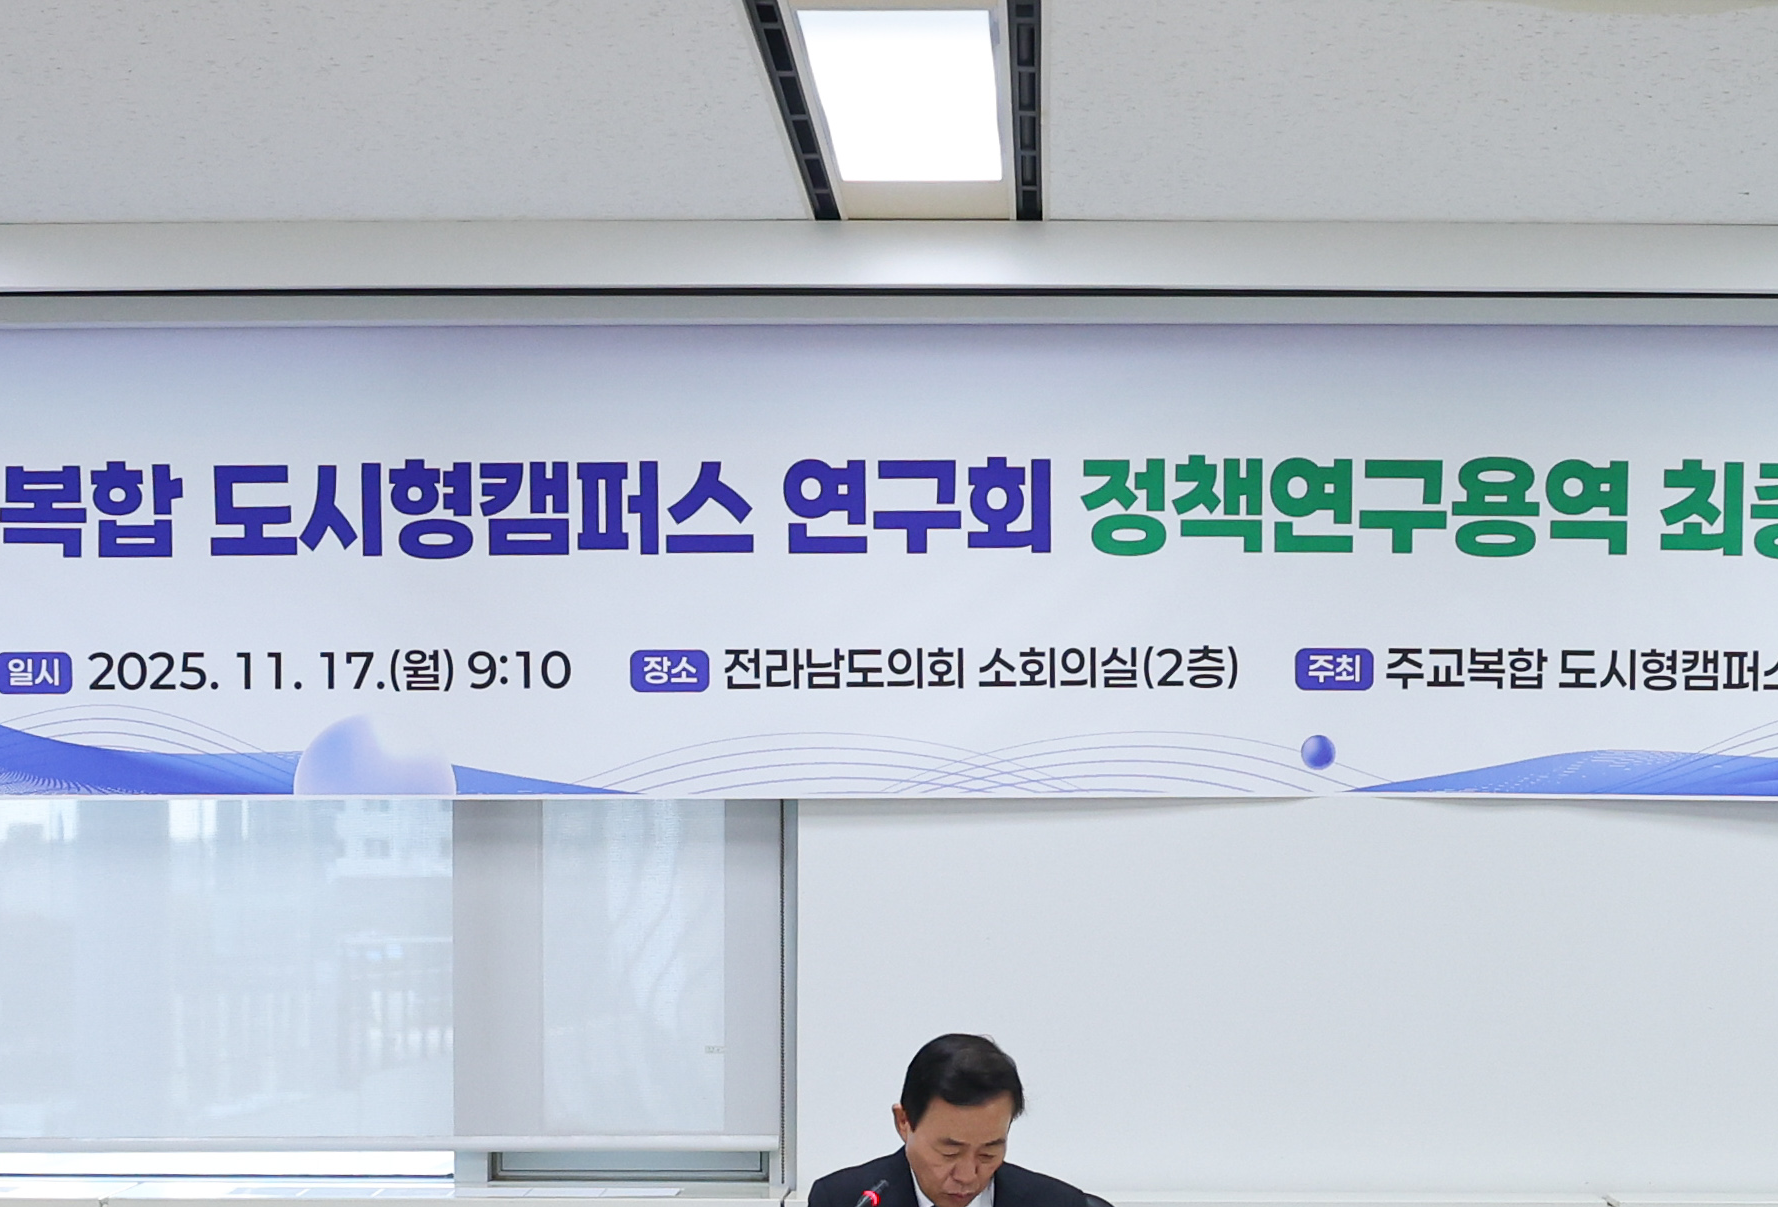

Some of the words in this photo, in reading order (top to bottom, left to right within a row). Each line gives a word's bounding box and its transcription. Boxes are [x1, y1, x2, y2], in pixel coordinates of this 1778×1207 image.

[210, 458, 755, 560] 도시형캠퍼스
[783, 455, 1052, 556] 연구회
[1081, 453, 1630, 558] 정책연구용역
[7, 658, 61, 687] 일시
[88, 650, 220, 692] 2025.
[235, 651, 303, 691] 11.
[467, 649, 572, 691] 9:10
[642, 656, 699, 686] 장소
[723, 646, 965, 691] 전라남도의회
[977, 645, 1239, 692] 소회의실(2층)
[1307, 654, 1362, 684] 주최
[1385, 646, 1549, 691] 주교복합
